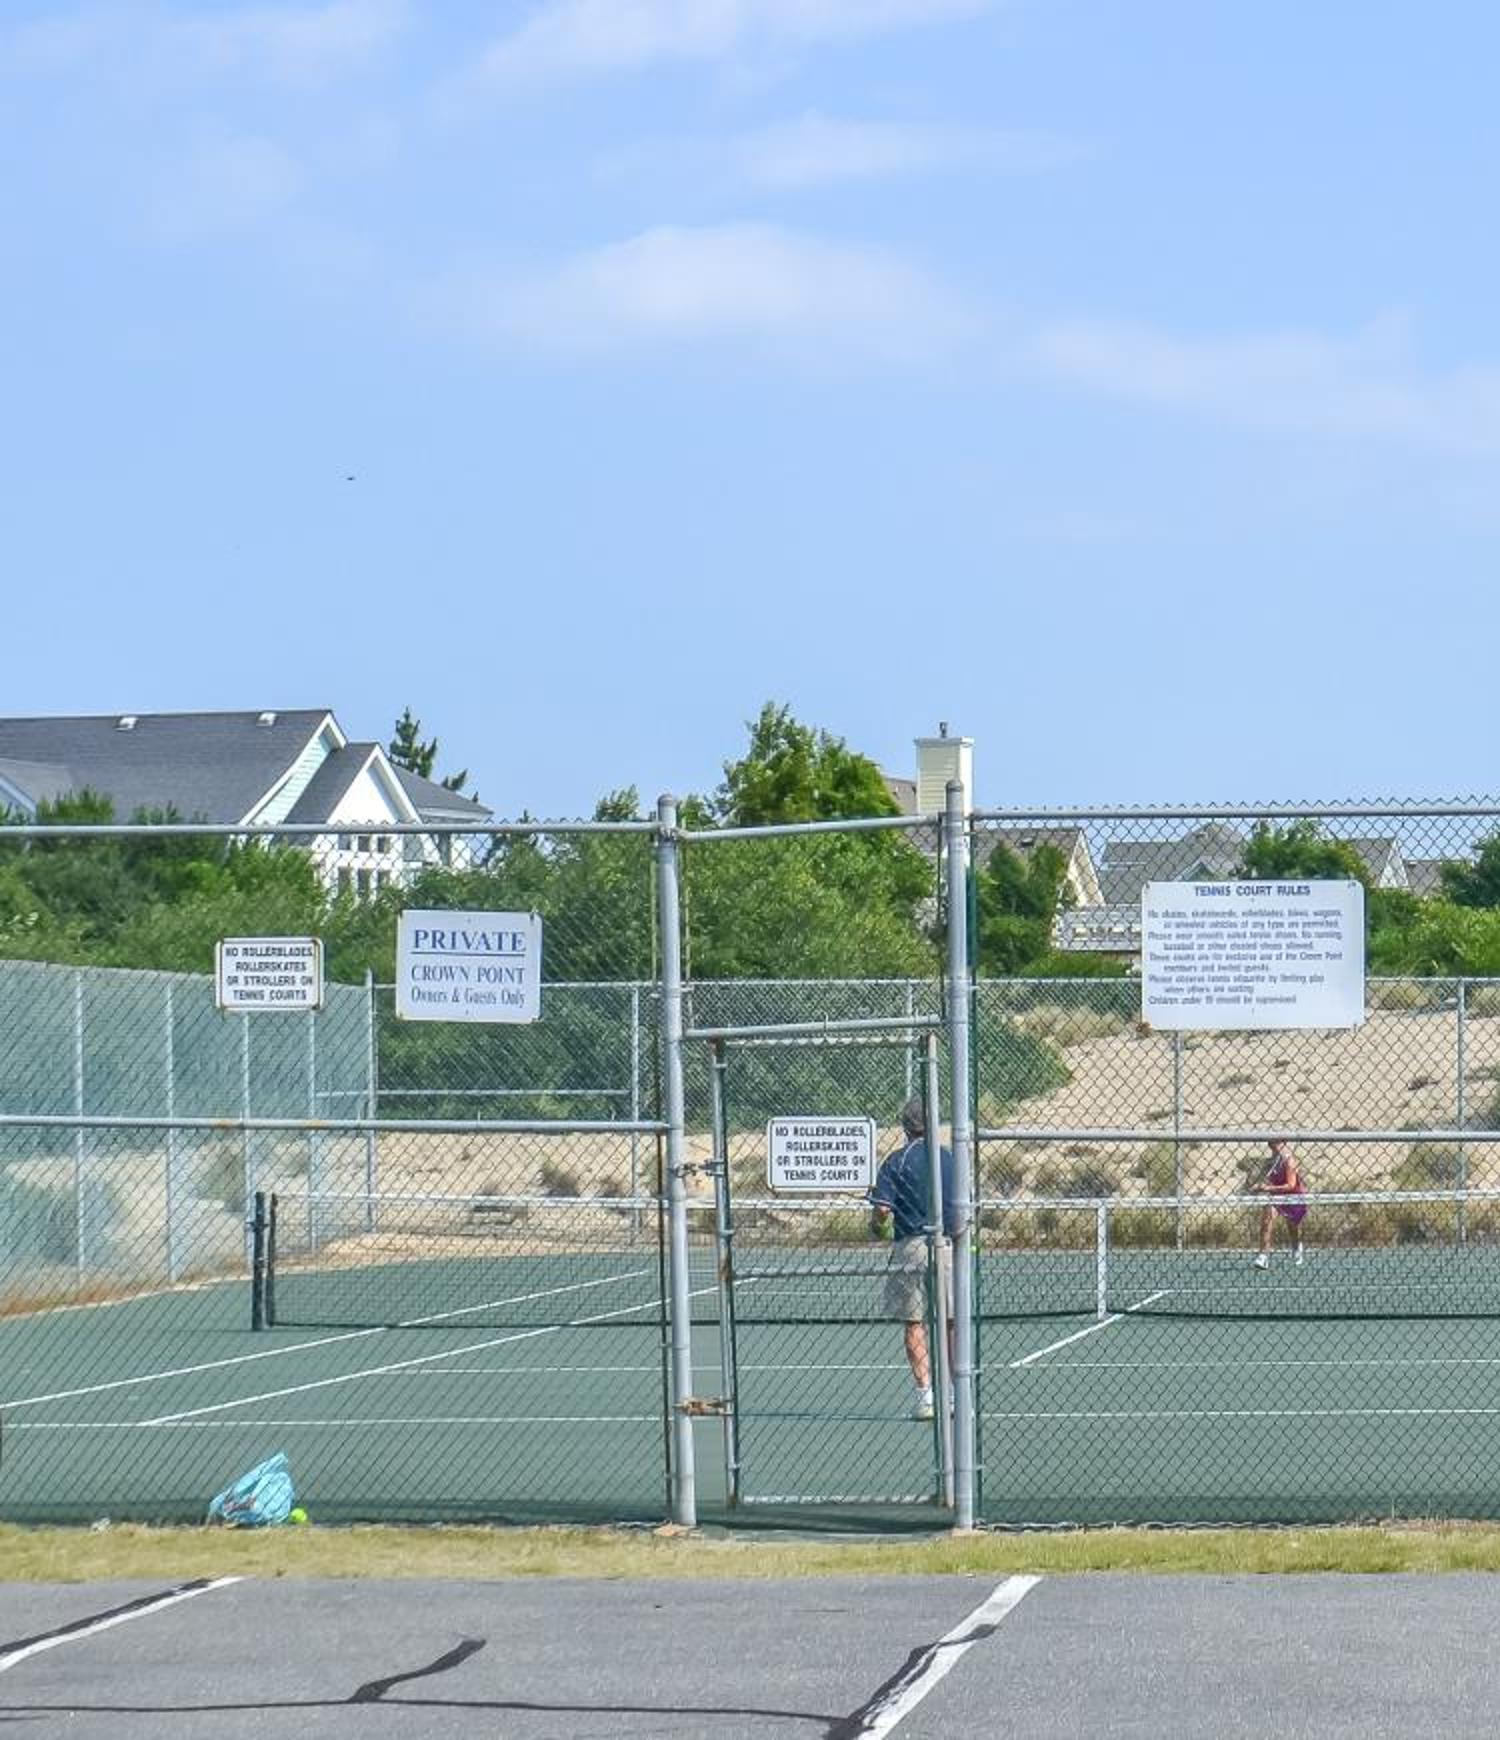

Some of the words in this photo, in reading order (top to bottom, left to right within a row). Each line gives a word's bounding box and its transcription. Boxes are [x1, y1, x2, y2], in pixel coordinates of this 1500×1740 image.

[1195, 885, 1231, 897] TENNIS
[1236, 885, 1272, 897] COURT
[1277, 885, 1311, 897] RULES
[414, 929, 526, 951] PRIVATE
[225, 947, 239, 957] NO
[235, 961, 307, 972] ROLLERSKATES
[226, 975, 239, 986] OR
[244, 975, 296, 986] STROLLERS
[300, 975, 314, 986] ON
[411, 965, 469, 982] CROWN
[477, 966, 525, 984] POINT
[233, 989, 264, 1001] TENNIS
[269, 989, 307, 1001] COURTS
[411, 986, 447, 1003] Owners
[451, 987, 460, 1003] &
[465, 988, 497, 1005] Guests
[501, 988, 525, 1009] Only
[775, 1126, 789, 1137] NO
[793, 1126, 866, 1138] ROLLERBLADES,
[785, 1141, 859, 1152] ROLLERSKATES
[776, 1155, 790, 1166] OR
[794, 1155, 848, 1166] STROLLERS
[852, 1155, 866, 1166] ON
[784, 1169, 817, 1181] TENNIS
[820, 1169, 859, 1181] COURTS
